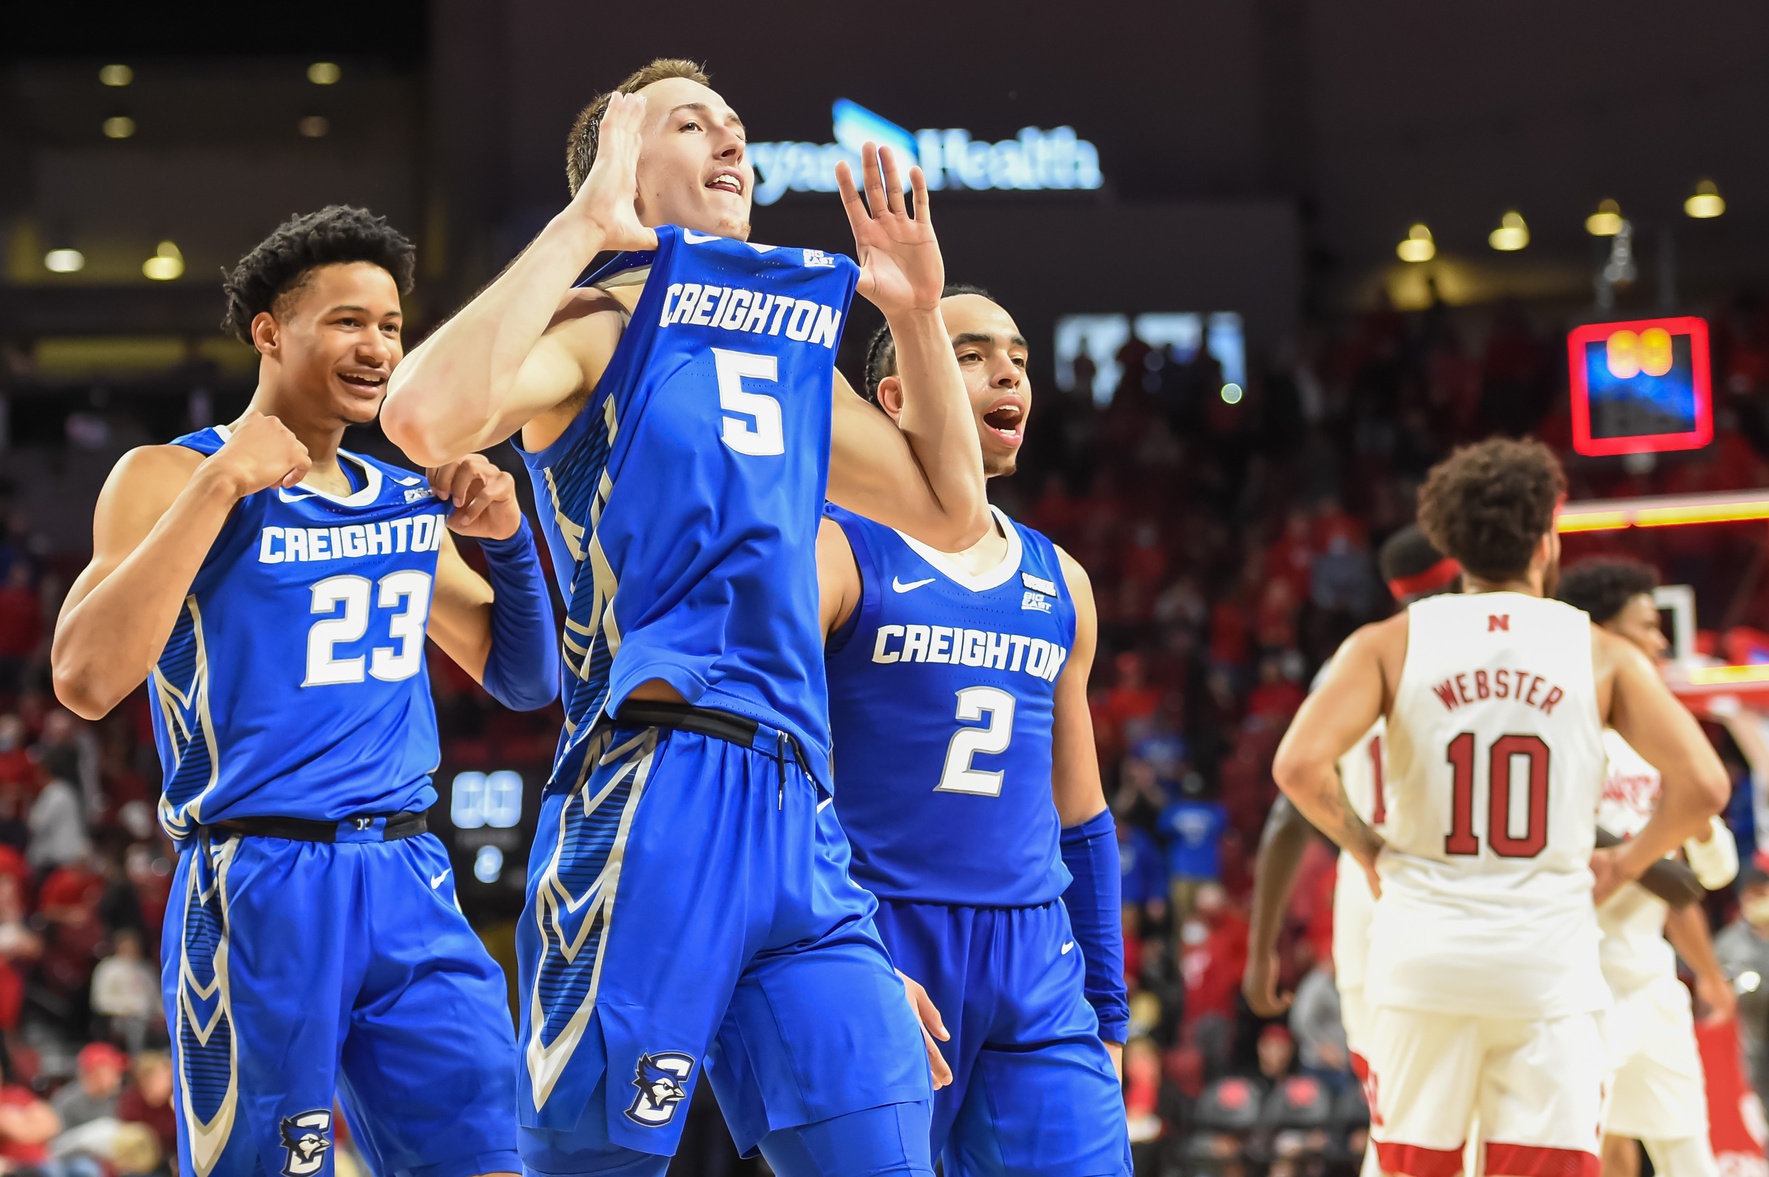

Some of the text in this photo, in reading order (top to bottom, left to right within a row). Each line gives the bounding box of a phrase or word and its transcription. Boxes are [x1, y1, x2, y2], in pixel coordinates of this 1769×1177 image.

[914, 126, 1105, 190] Health
[659, 283, 842, 349] CREIGHTON
[710, 347, 785, 456] 5
[300, 569, 432, 687] 23
[871, 624, 1067, 682] CREIGHTON
[1487, 614, 1510, 632] N
[1432, 668, 1565, 717] WEBSTER
[932, 685, 1016, 797] 2
[1444, 732, 1550, 858] 10
